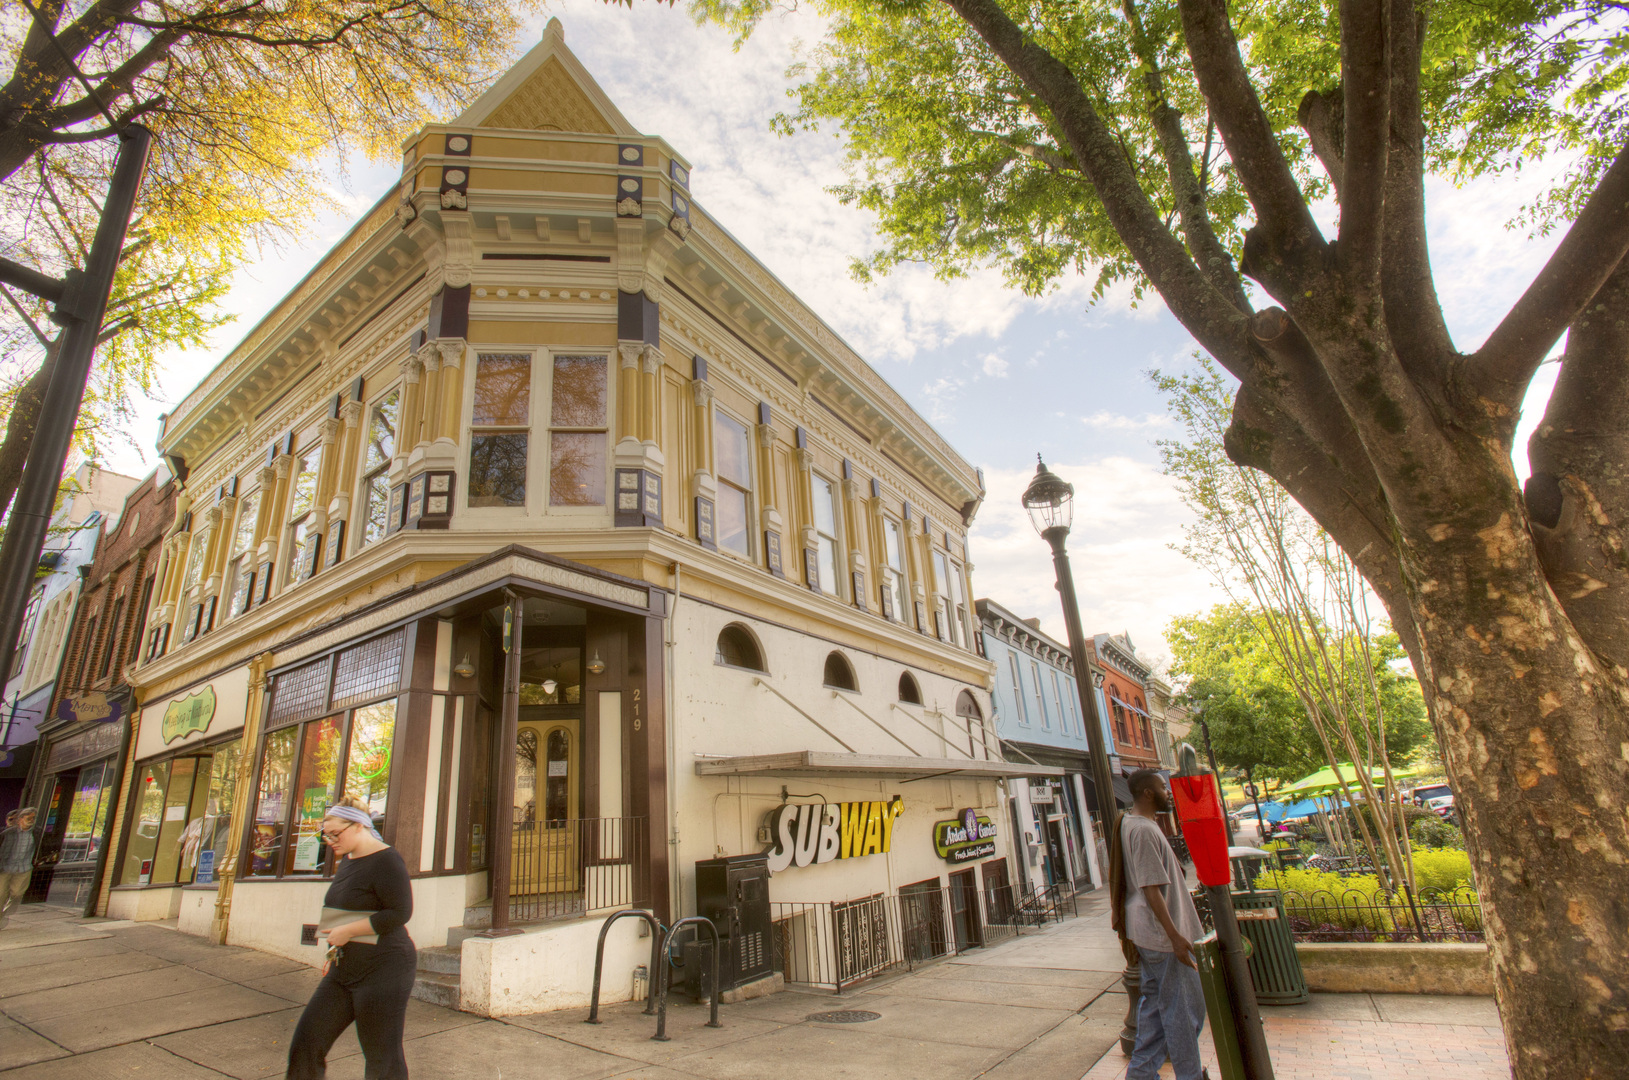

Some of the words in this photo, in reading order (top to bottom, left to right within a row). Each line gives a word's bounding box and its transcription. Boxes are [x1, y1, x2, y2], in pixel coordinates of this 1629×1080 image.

[71, 700, 112, 717] Margo
[767, 797, 905, 878] SUBWAY
[978, 822, 997, 839] Garden
[955, 849, 966, 860] Fresh
